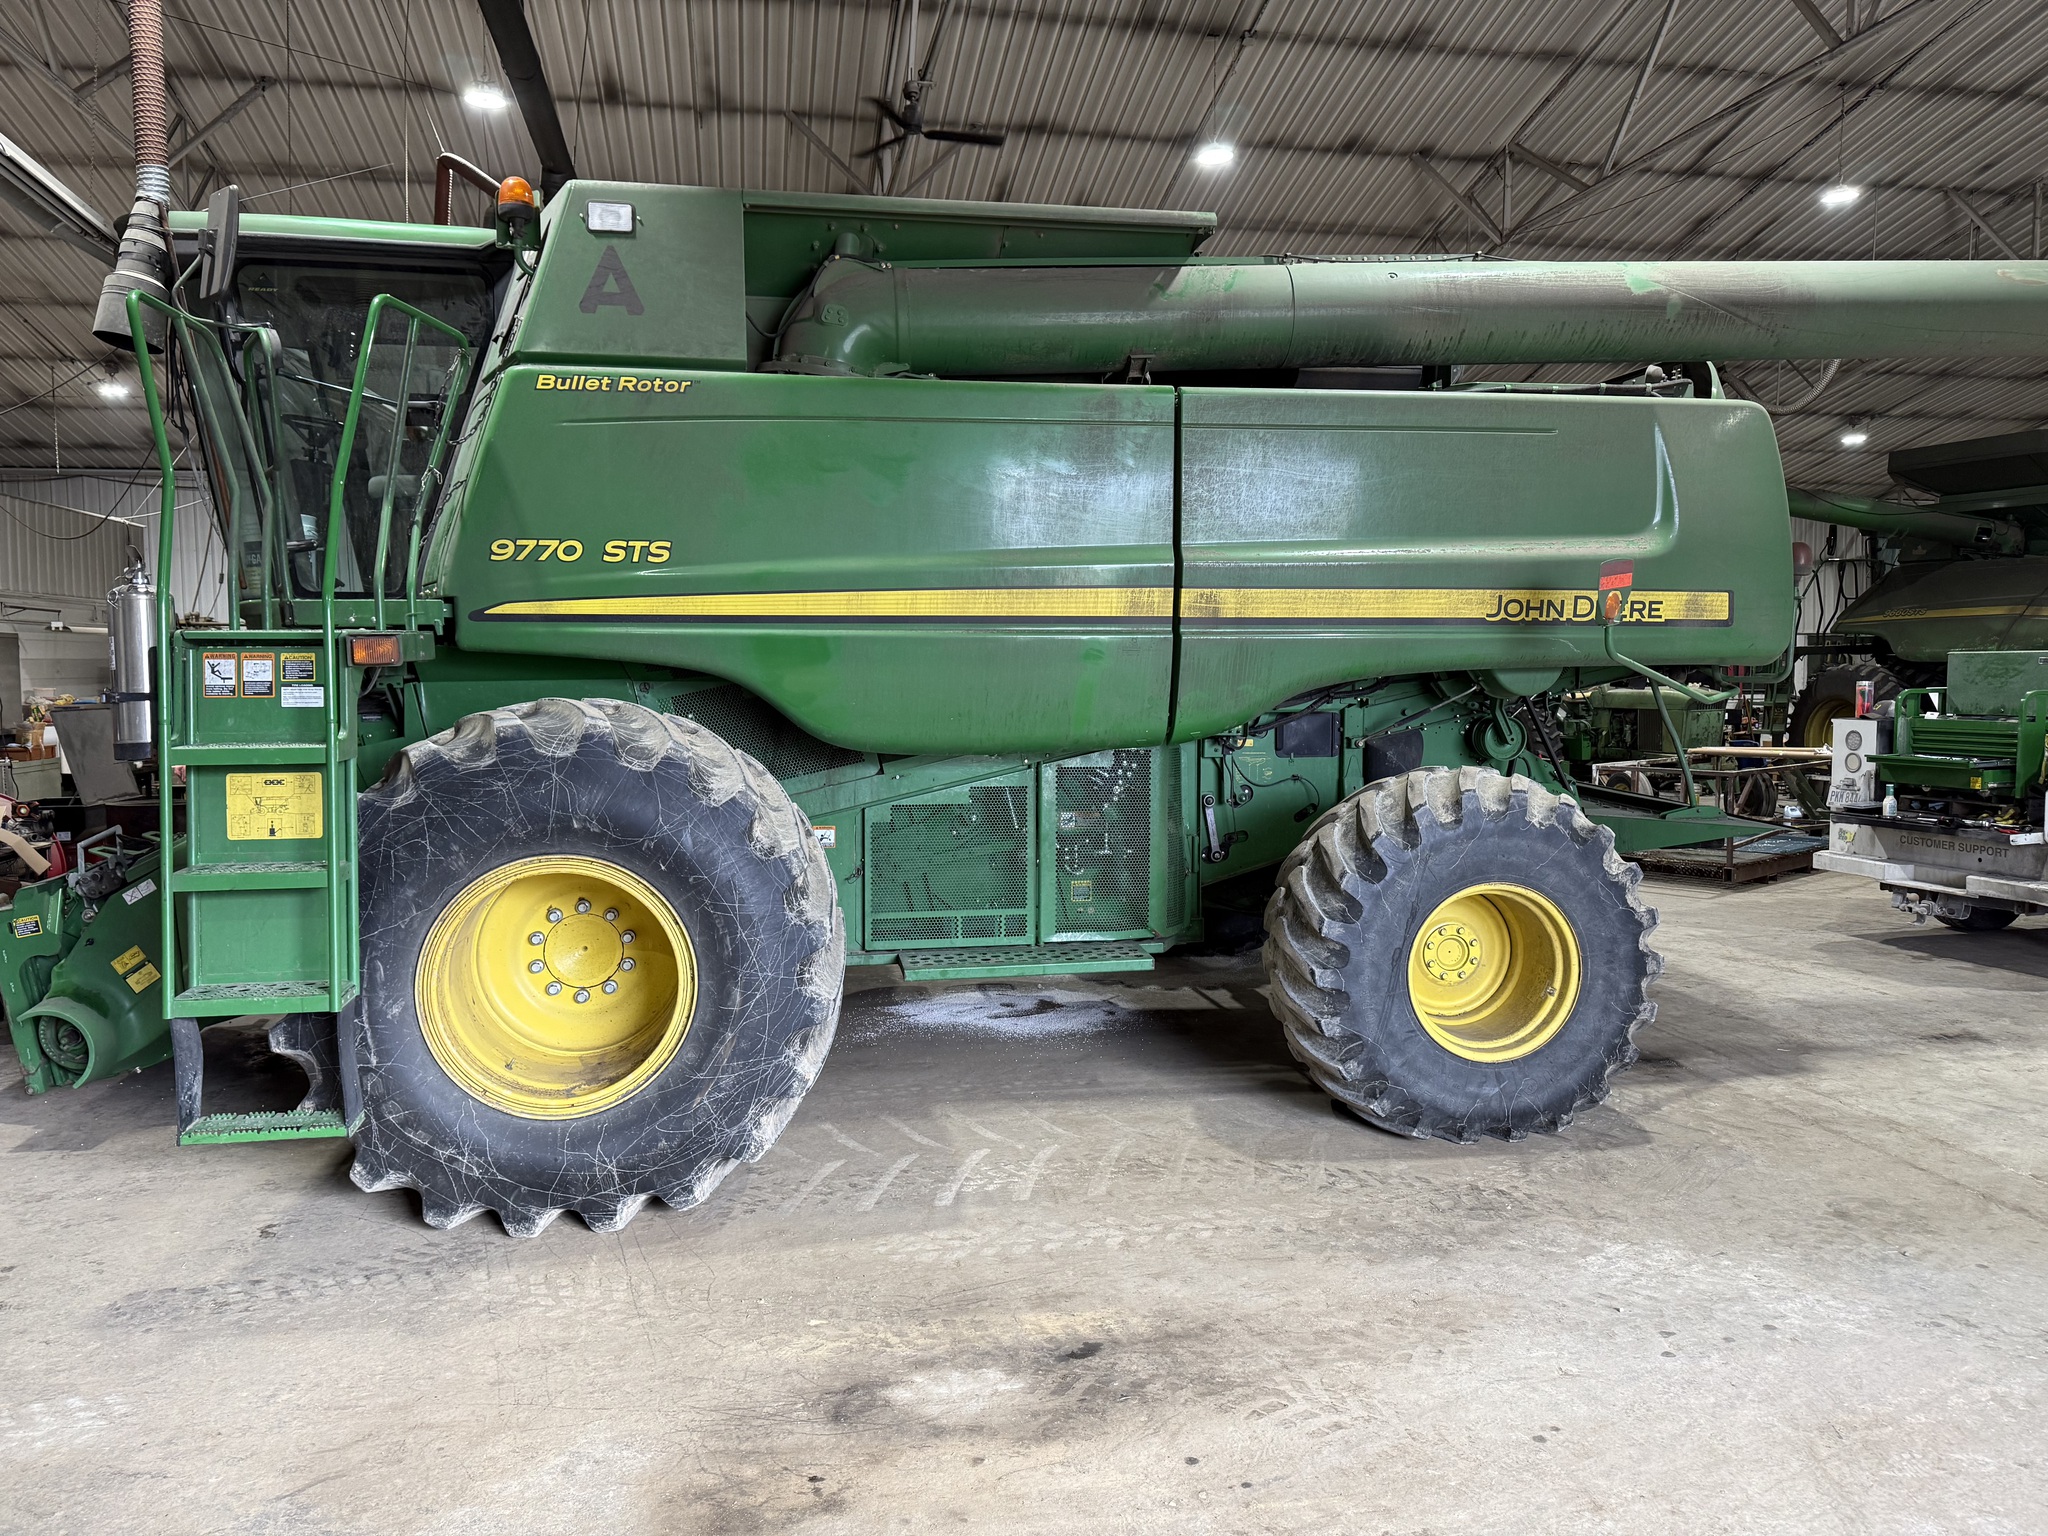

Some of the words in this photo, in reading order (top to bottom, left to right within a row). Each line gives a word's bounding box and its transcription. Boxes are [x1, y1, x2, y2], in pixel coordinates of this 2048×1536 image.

[578, 245, 645, 316] A
[535, 374, 612, 391] Bullet
[617, 376, 692, 393] Rotor
[489, 539, 584, 562] 9770
[602, 540, 672, 563] STS
[1486, 595, 1565, 618] JOHN
[1573, 595, 1664, 619] DRE
[1900, 834, 1955, 851] CUSTOMER
[1958, 842, 2009, 858] SUPPORT
